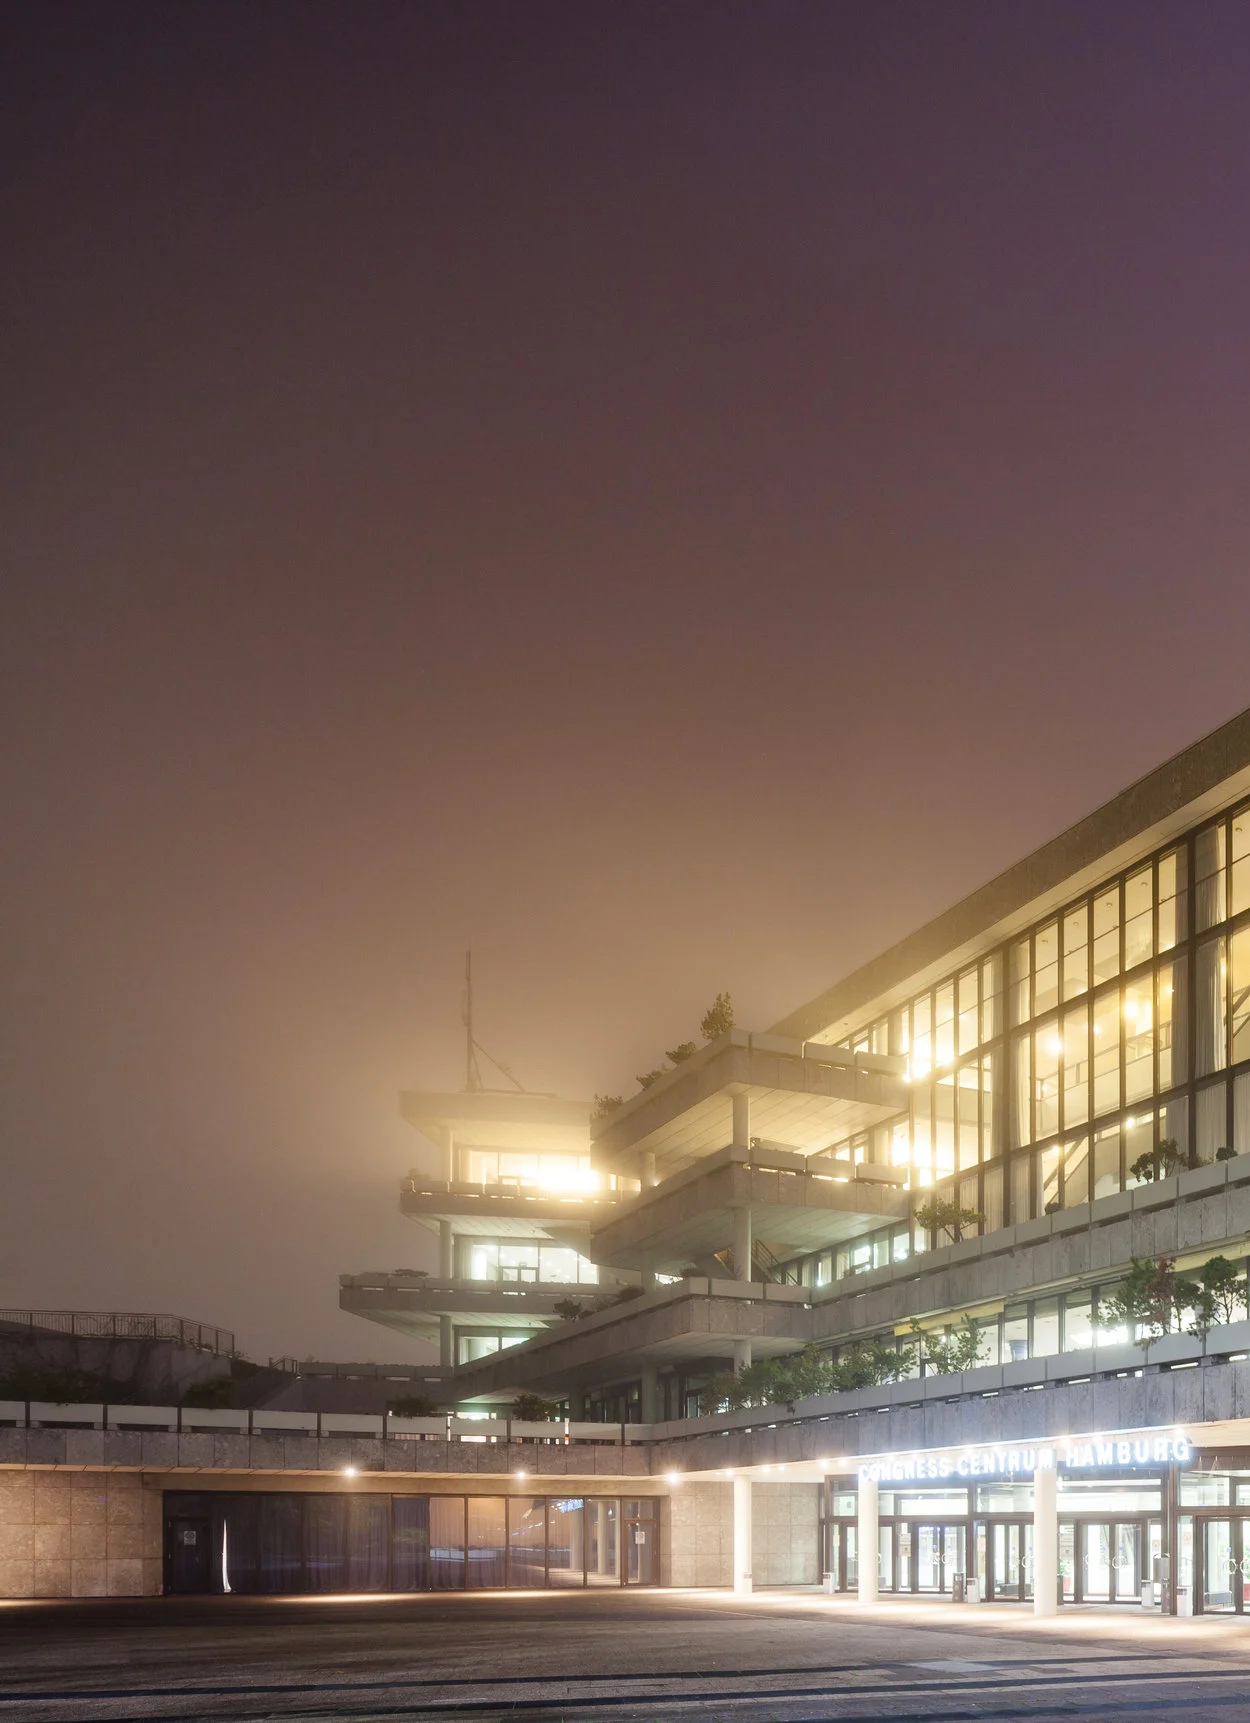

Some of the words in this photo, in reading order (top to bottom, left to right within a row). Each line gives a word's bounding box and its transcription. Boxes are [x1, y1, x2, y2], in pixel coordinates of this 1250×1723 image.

[858, 1457, 950, 1482] CONGRESS
[956, 1447, 1053, 1476] CENTRUM
[1065, 1437, 1189, 1467] HAMBURG
